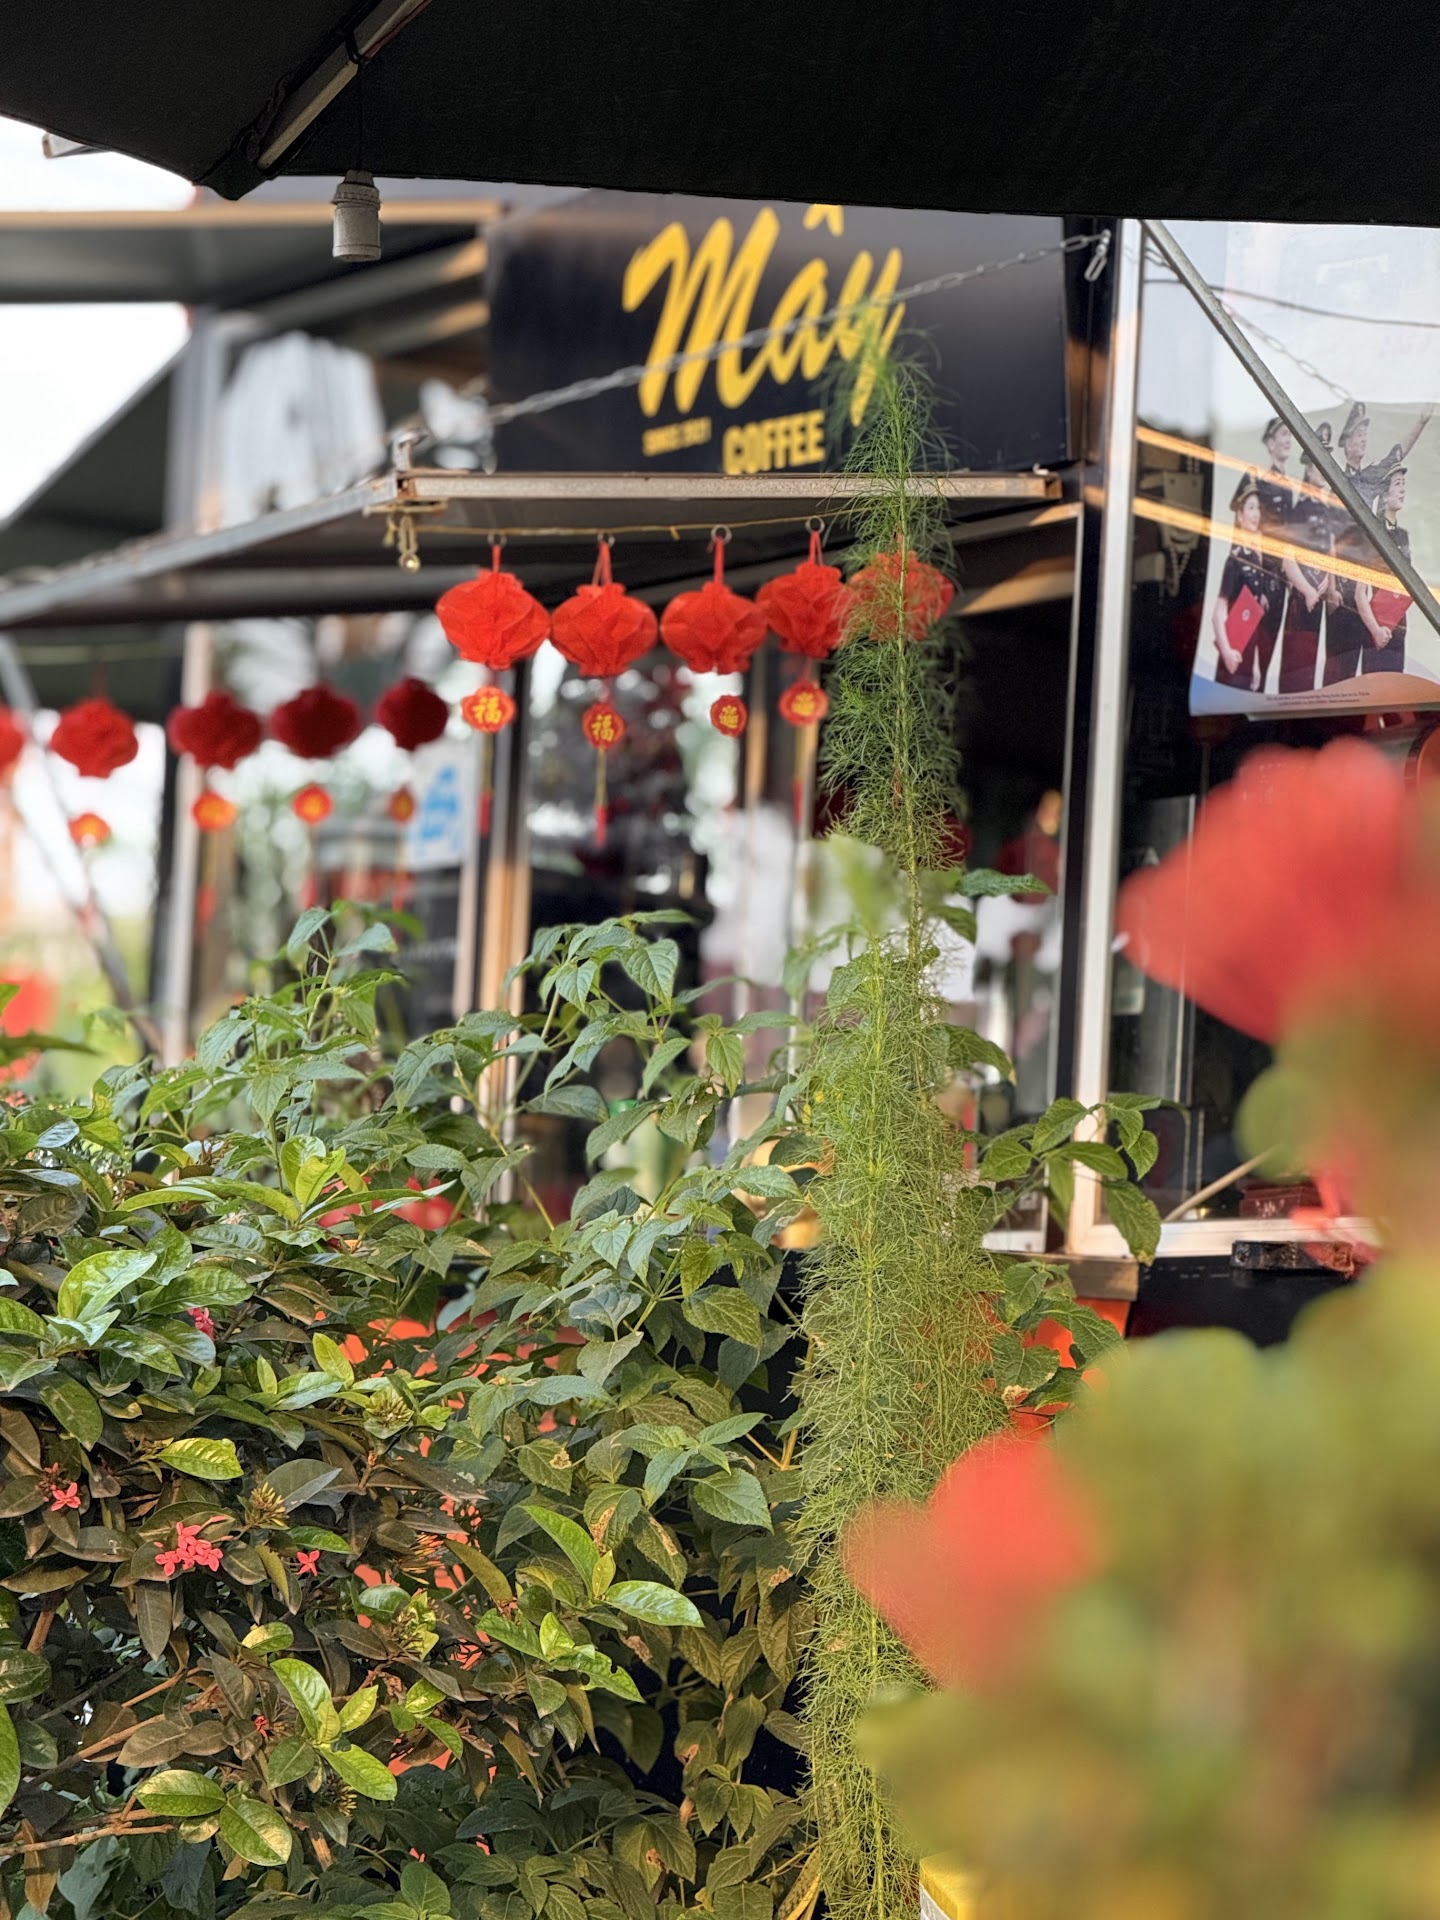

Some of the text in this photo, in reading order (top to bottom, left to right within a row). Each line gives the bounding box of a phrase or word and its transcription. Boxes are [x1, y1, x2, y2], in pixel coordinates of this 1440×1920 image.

[722, 409, 826, 476] COFFEE
[472, 695, 503, 725] 福
[591, 713, 615, 742] 福
